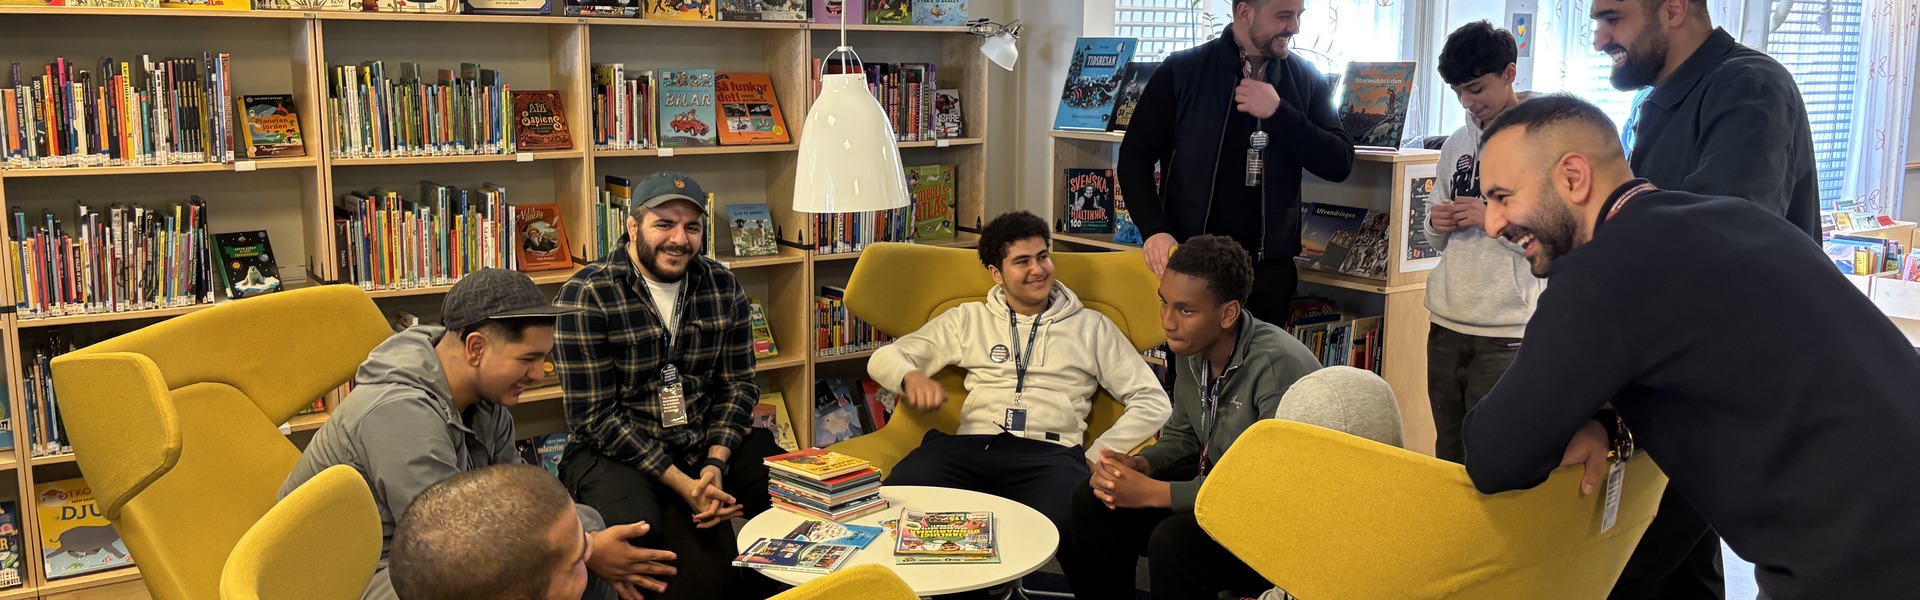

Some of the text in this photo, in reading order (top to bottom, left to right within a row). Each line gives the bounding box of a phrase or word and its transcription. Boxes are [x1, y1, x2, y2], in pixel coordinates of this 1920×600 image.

[1086, 55, 1116, 66] TIDSRESAN
[715, 81, 767, 92] Så funkar
[665, 93, 710, 107] BILAR
[717, 93, 740, 102] det!
[530, 103, 547, 113] APA
[1070, 172, 1109, 192] SVENSKA
[916, 198, 948, 221] ATLAS
[1317, 208, 1356, 219] Utvandringen
[1070, 219, 1082, 228] 100
